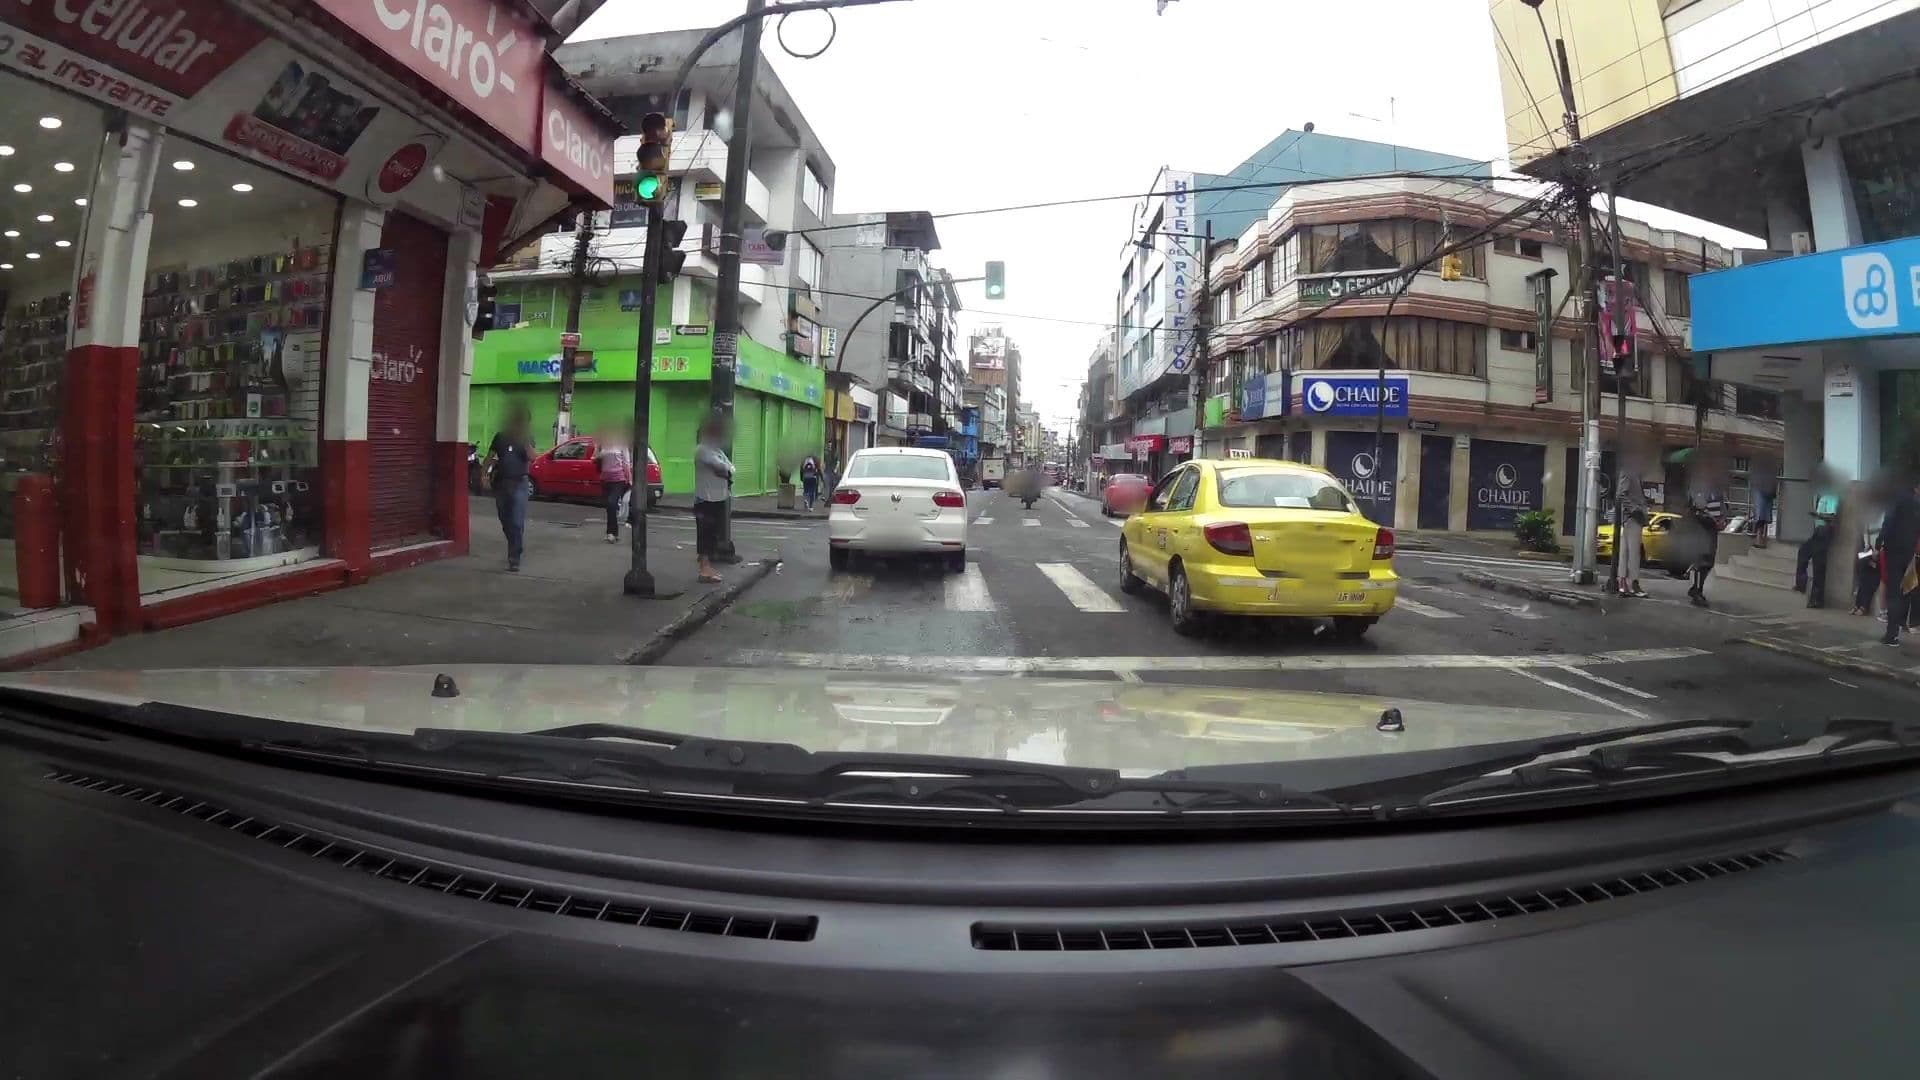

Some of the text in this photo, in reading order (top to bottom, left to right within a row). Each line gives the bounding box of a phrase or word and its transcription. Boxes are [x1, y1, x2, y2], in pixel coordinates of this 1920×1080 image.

[548, 108, 602, 179] Claro
[1174, 180, 1188, 244] HOTEL
[1345, 275, 1406, 297] GENOVA
[1173, 261, 1187, 370] PACIFICO
[1534, 276, 1546, 382] HOTEL
[371, 351, 416, 383] Claro
[1335, 386, 1400, 402] CHAIDE
[1232, 450, 1249, 459] TAXI
[1478, 487, 1531, 505] CHAIDE
